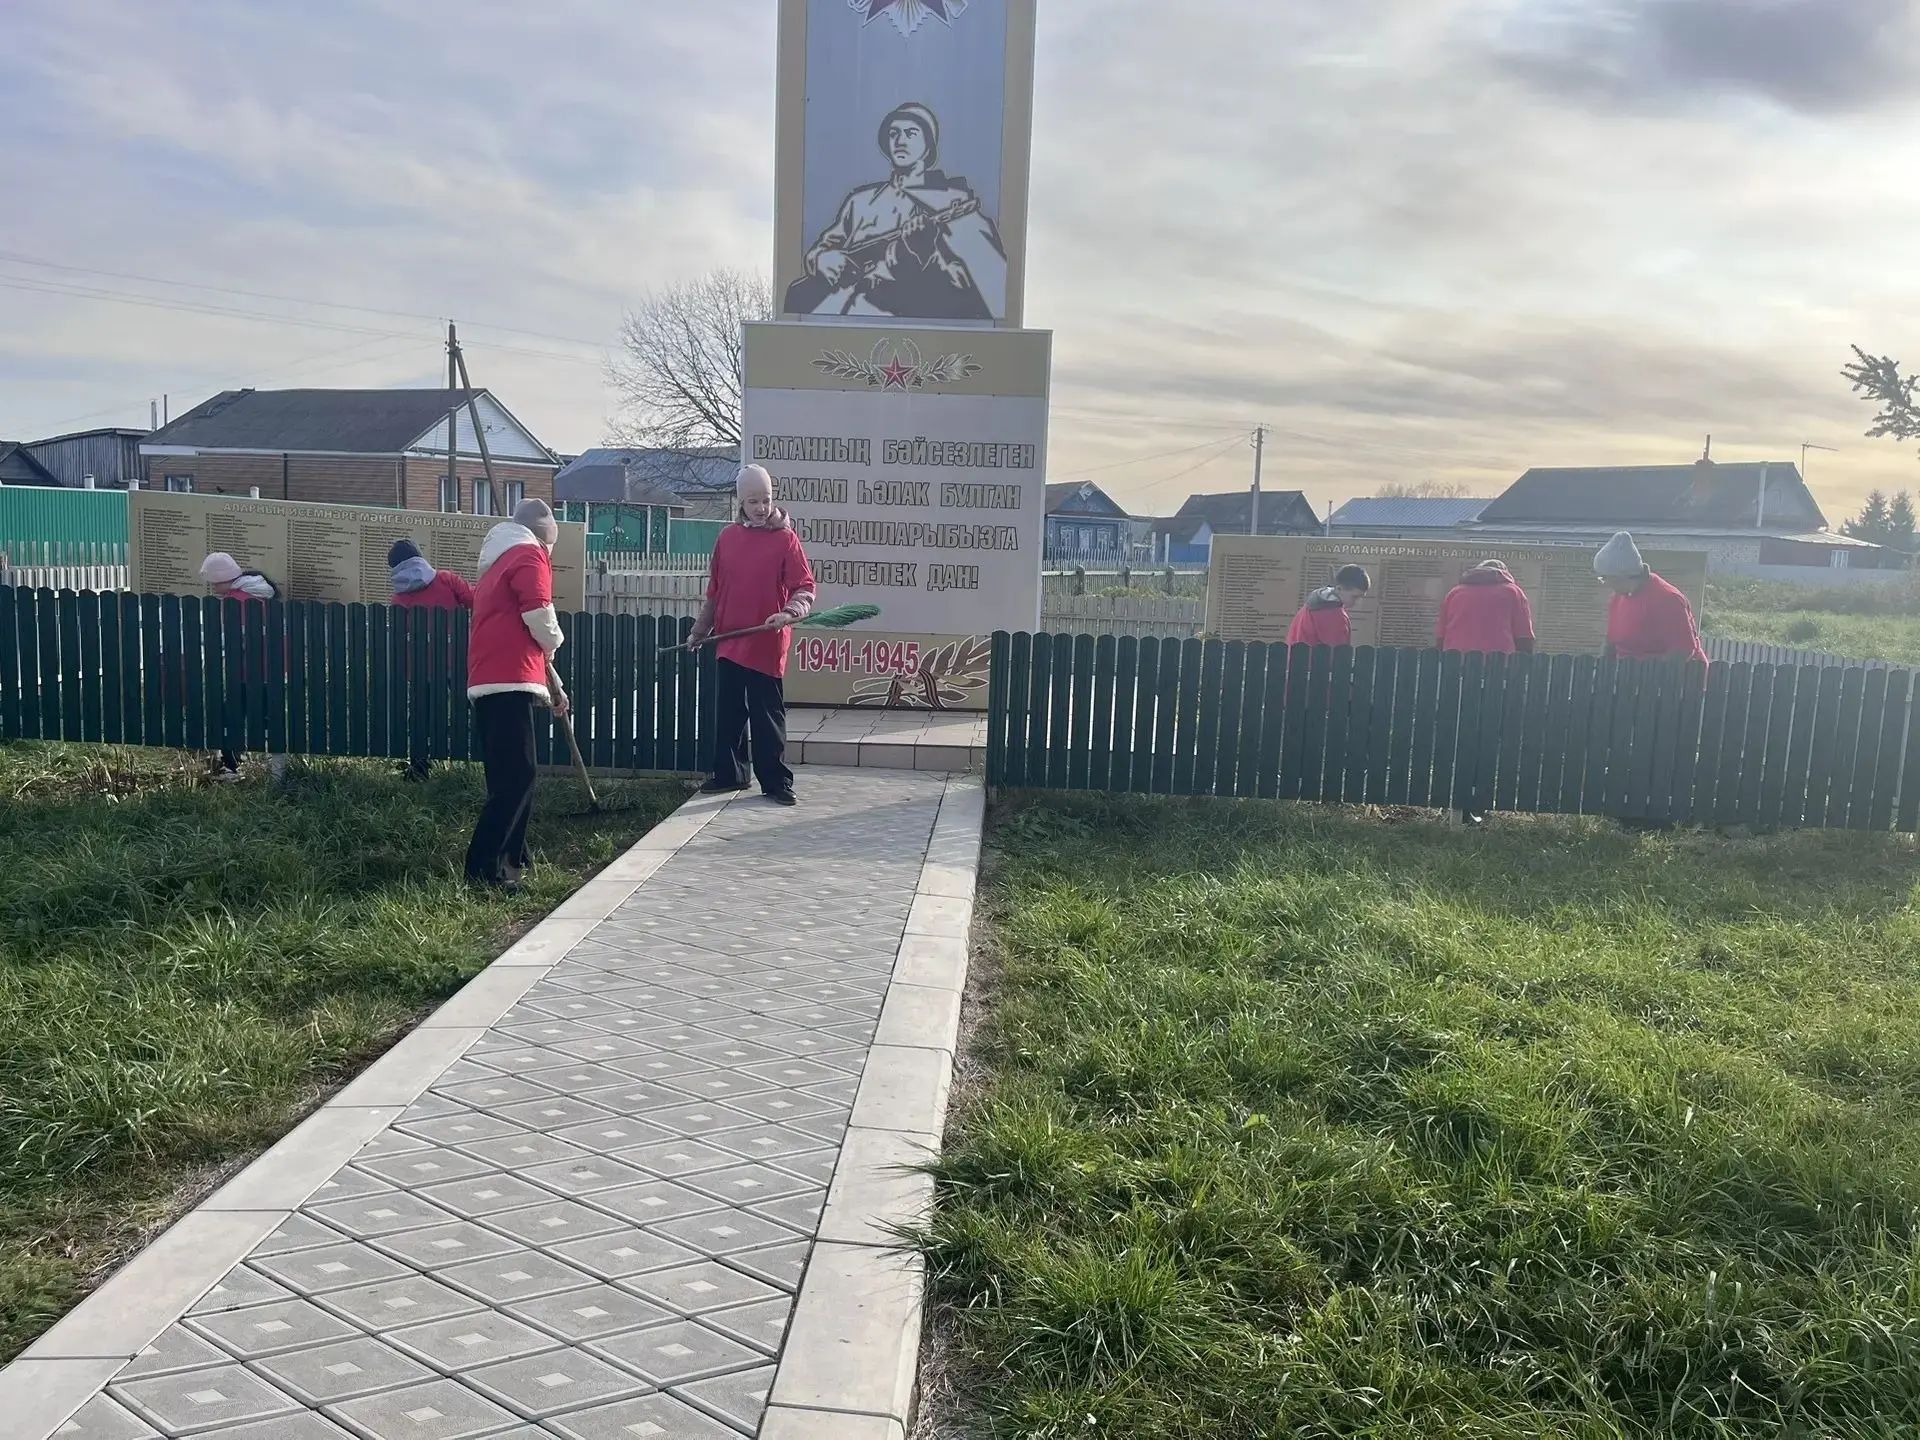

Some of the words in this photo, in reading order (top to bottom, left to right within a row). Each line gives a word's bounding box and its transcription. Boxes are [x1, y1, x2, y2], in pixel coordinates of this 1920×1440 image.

[753, 434, 871, 466] ВАТАННЫҢ
[882, 436, 1035, 469] БӘЙСЕЗЛЕГЕН
[940, 482, 1021, 510] БУЛГАН
[289, 507, 358, 521] ИСЕМНӘРЕ
[405, 515, 489, 530] ОНЫТЫЛМАС
[927, 563, 980, 592] ДАН!
[795, 636, 920, 677] 1941-1945
